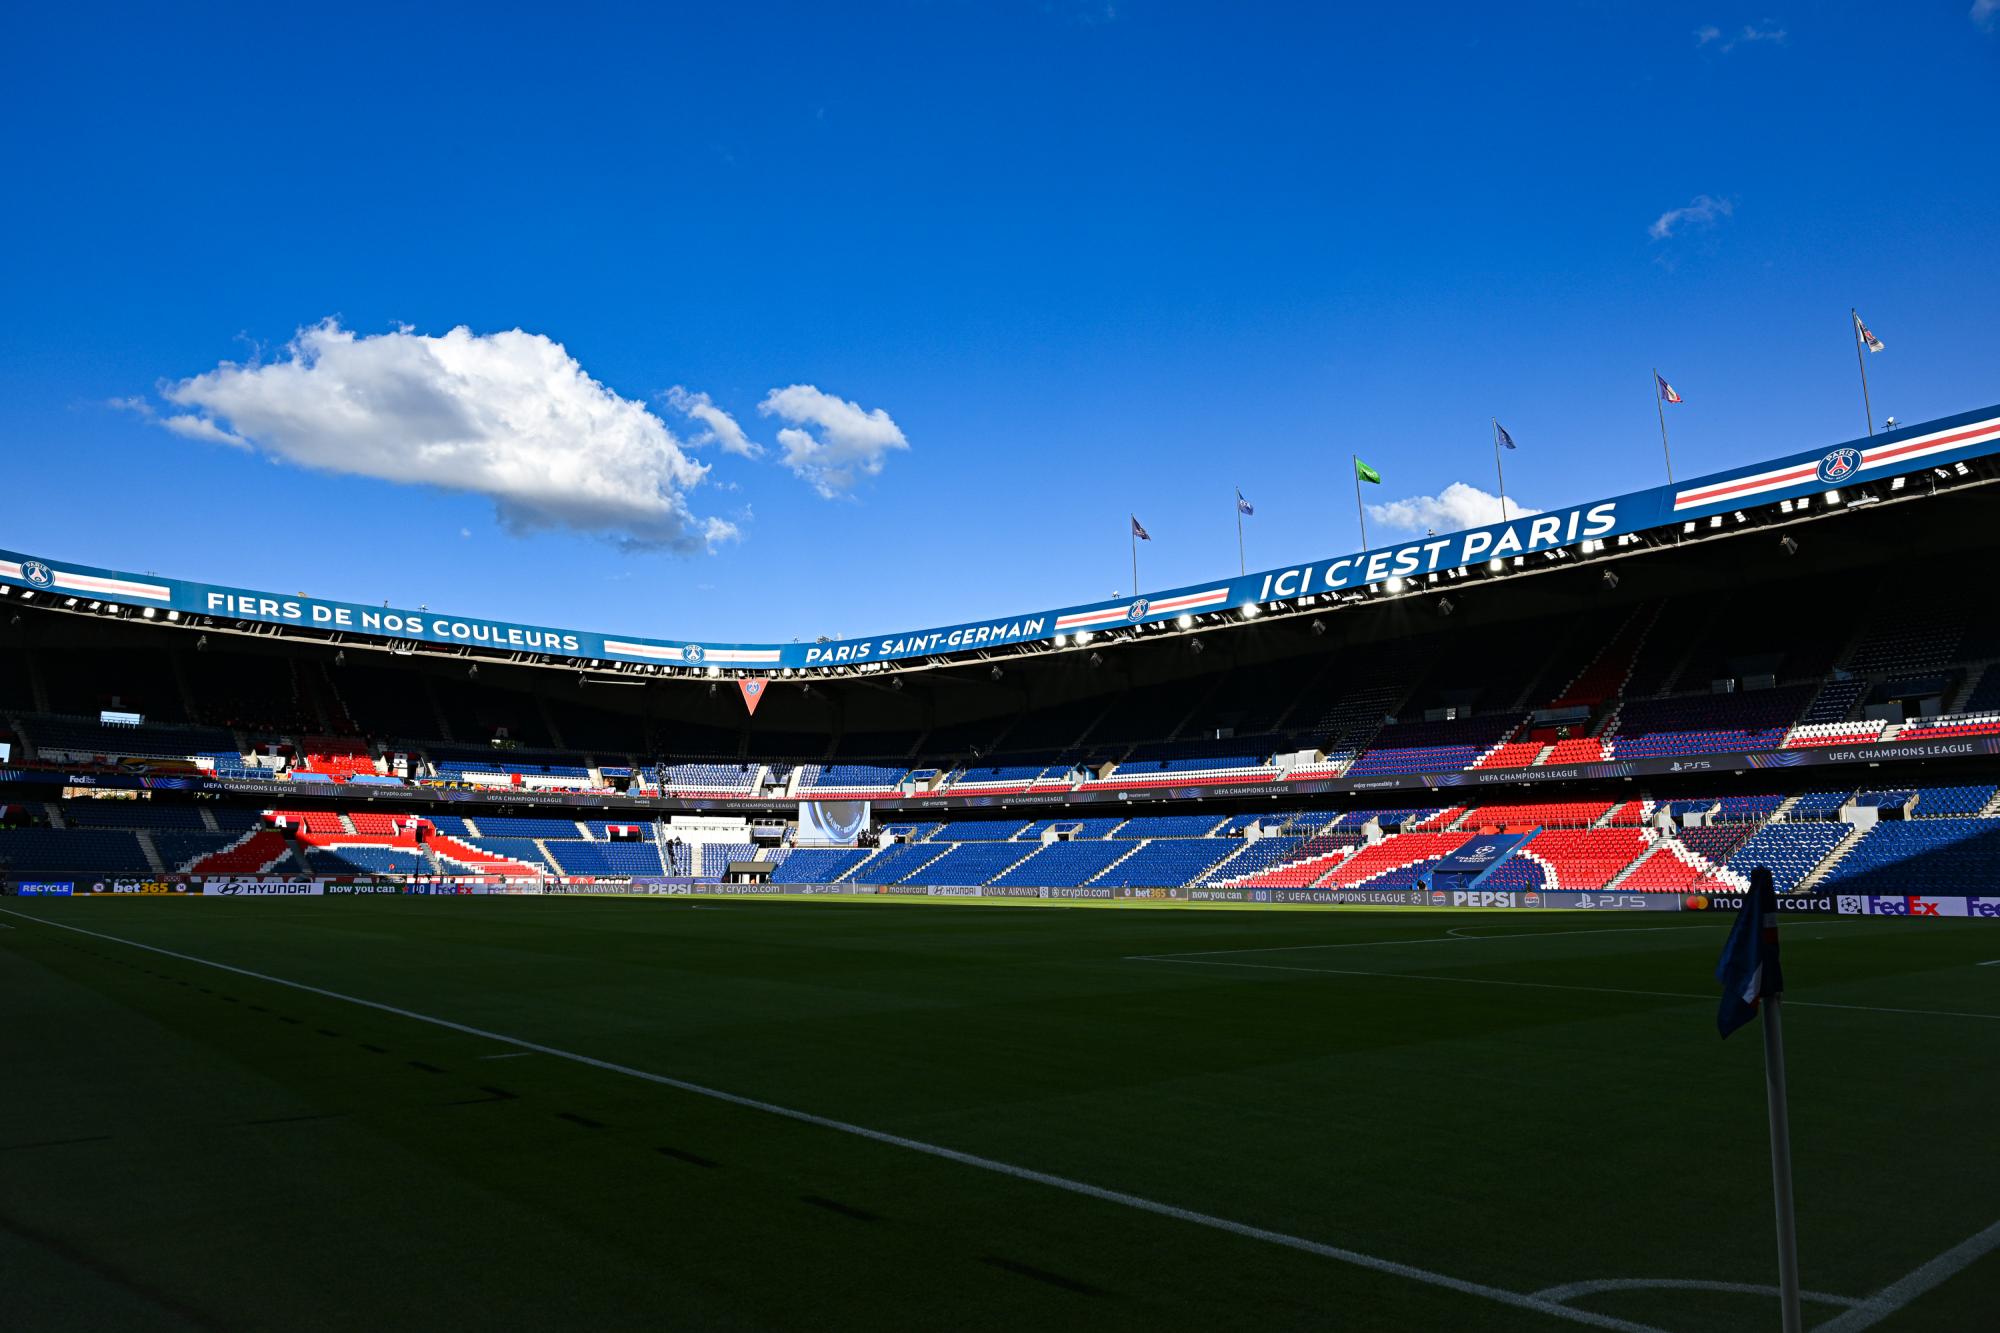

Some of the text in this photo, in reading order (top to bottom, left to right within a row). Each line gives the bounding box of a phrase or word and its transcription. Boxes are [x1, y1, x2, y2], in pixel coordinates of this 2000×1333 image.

[1826, 449, 1855, 462] PARIS
[1259, 502, 1616, 600] ICI C'EST PARIS
[207, 592, 580, 650] FIERS DE NOS COULEURS
[805, 617, 1045, 663] PARIS SAINT-GERMAIN
[1829, 744, 1973, 760] UEFA CHAMPIONS LEAGUE
[1683, 761, 1710, 769] PS5
[1499, 772, 1545, 780] CHAMPIONS
[1547, 769, 1577, 777] LEAGUE
[203, 782, 297, 793] UEFA CHAMPIONS LEAGUE
[1229, 787, 1264, 795] CHAMPIONS
[22, 884, 69, 892] RECYCLE
[113, 882, 169, 893] bet365
[248, 884, 312, 894] HYUNDAI
[354, 886, 377, 895] you
[545, 884, 625, 895] QATAR AIRWAYS
[648, 883, 692, 894] PEPSI
[726, 884, 780, 894] crypto.com
[889, 885, 927, 893] mastercard
[946, 886, 976, 895] HYUNDAI
[983, 887, 1038, 896] QATAR AIRWAYS
[1135, 887, 1166, 897] bet365
[1061, 888, 1110, 899] crypto.com
[1192, 890, 1242, 901] now you can
[1288, 892, 1406, 903] UEFA CHAMPIONS LEAGUE
[1453, 891, 1516, 908] PEPSI
[1599, 896, 1646, 908] PS5
[1713, 897, 1830, 910] marcard
[1868, 896, 1940, 917] FedEx
